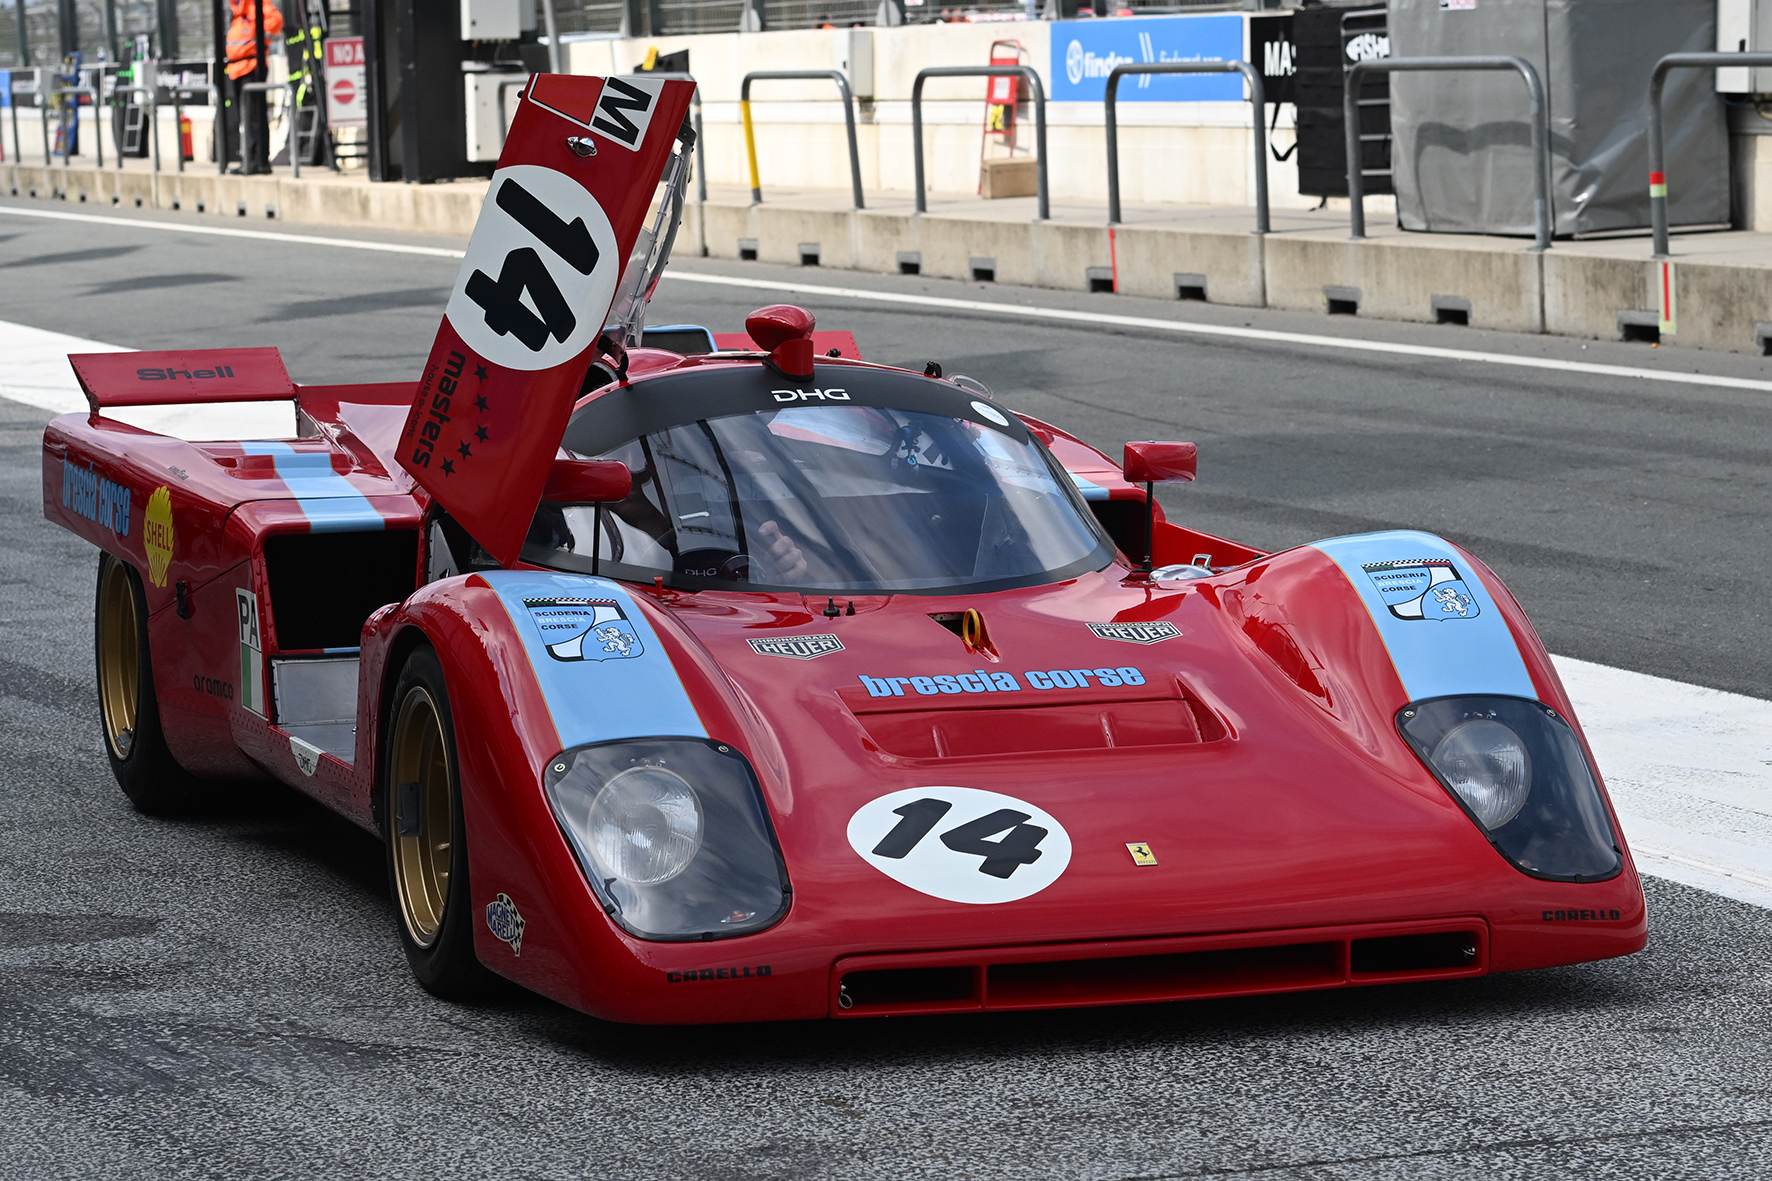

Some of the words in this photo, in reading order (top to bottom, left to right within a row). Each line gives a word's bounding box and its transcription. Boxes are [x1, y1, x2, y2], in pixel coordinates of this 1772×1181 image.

[333, 43, 354, 64] NO
[592, 76, 652, 146] M
[464, 177, 600, 353] 14
[136, 365, 235, 381] Shell
[771, 388, 851, 402] DHG
[412, 350, 466, 469] masters
[63, 450, 97, 522] brescia
[98, 477, 131, 537] corse
[146, 519, 171, 552] SHELL
[1373, 572, 1427, 581] SCUDERIA
[1377, 579, 1424, 587] BRESCIA
[1381, 585, 1417, 593] CORSE
[237, 593, 260, 649] PA
[1101, 627, 1174, 641] HEUER
[761, 640, 835, 656] HEUER
[193, 674, 234, 701] aramco
[857, 669, 1022, 698] brescia
[1024, 666, 1147, 691] corse
[871, 797, 1049, 880] 14
[1542, 910, 1620, 921] CARELLO
[666, 965, 772, 983] CARELLO
